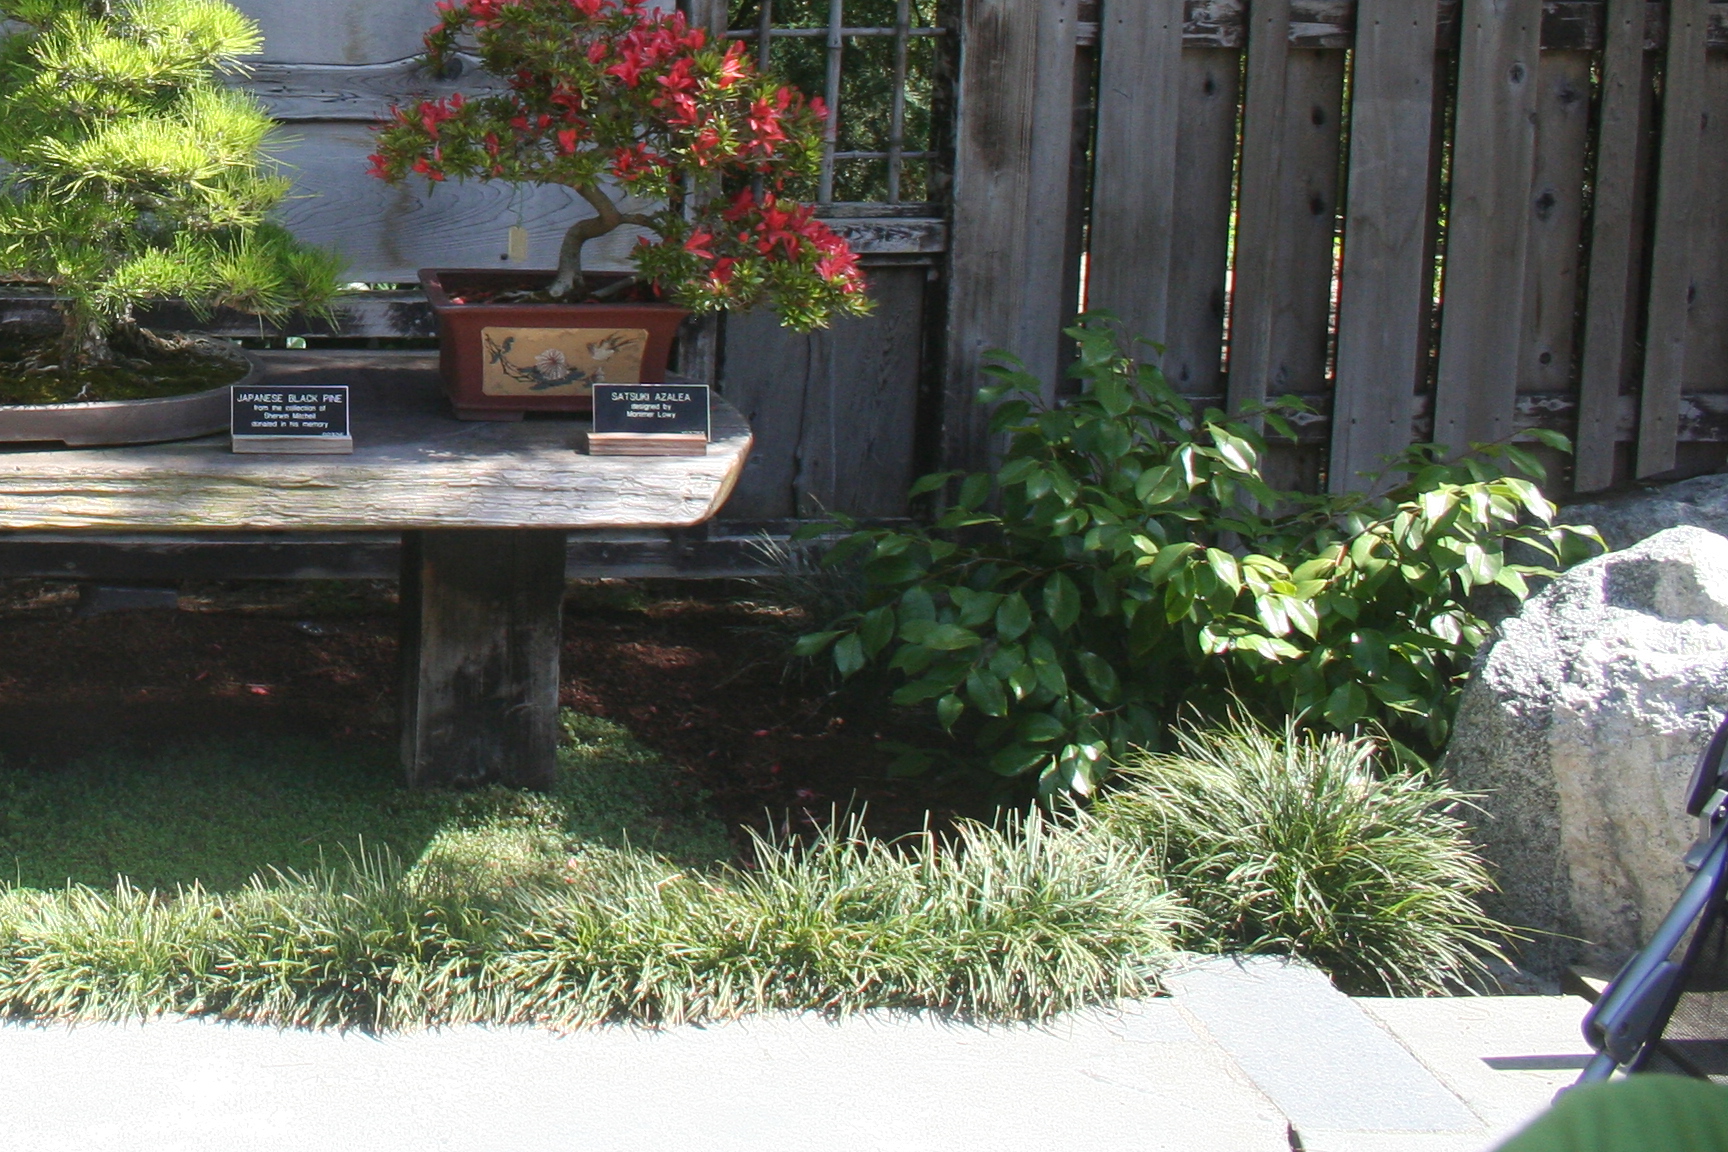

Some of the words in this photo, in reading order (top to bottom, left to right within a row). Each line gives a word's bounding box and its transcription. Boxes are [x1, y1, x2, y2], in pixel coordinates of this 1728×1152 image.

[236, 393, 283, 403] JAPANESE
[288, 393, 318, 403] BLACK
[322, 393, 343, 403] PINE
[611, 391, 650, 401] SATSUKI
[654, 392, 692, 402] AZALEA
[253, 404, 269, 412] from
[272, 404, 282, 412] the
[285, 404, 317, 412] collection
[319, 404, 326, 412] of
[630, 403, 660, 411] designed
[662, 403, 672, 411] by
[657, 411, 676, 419] Lowy
